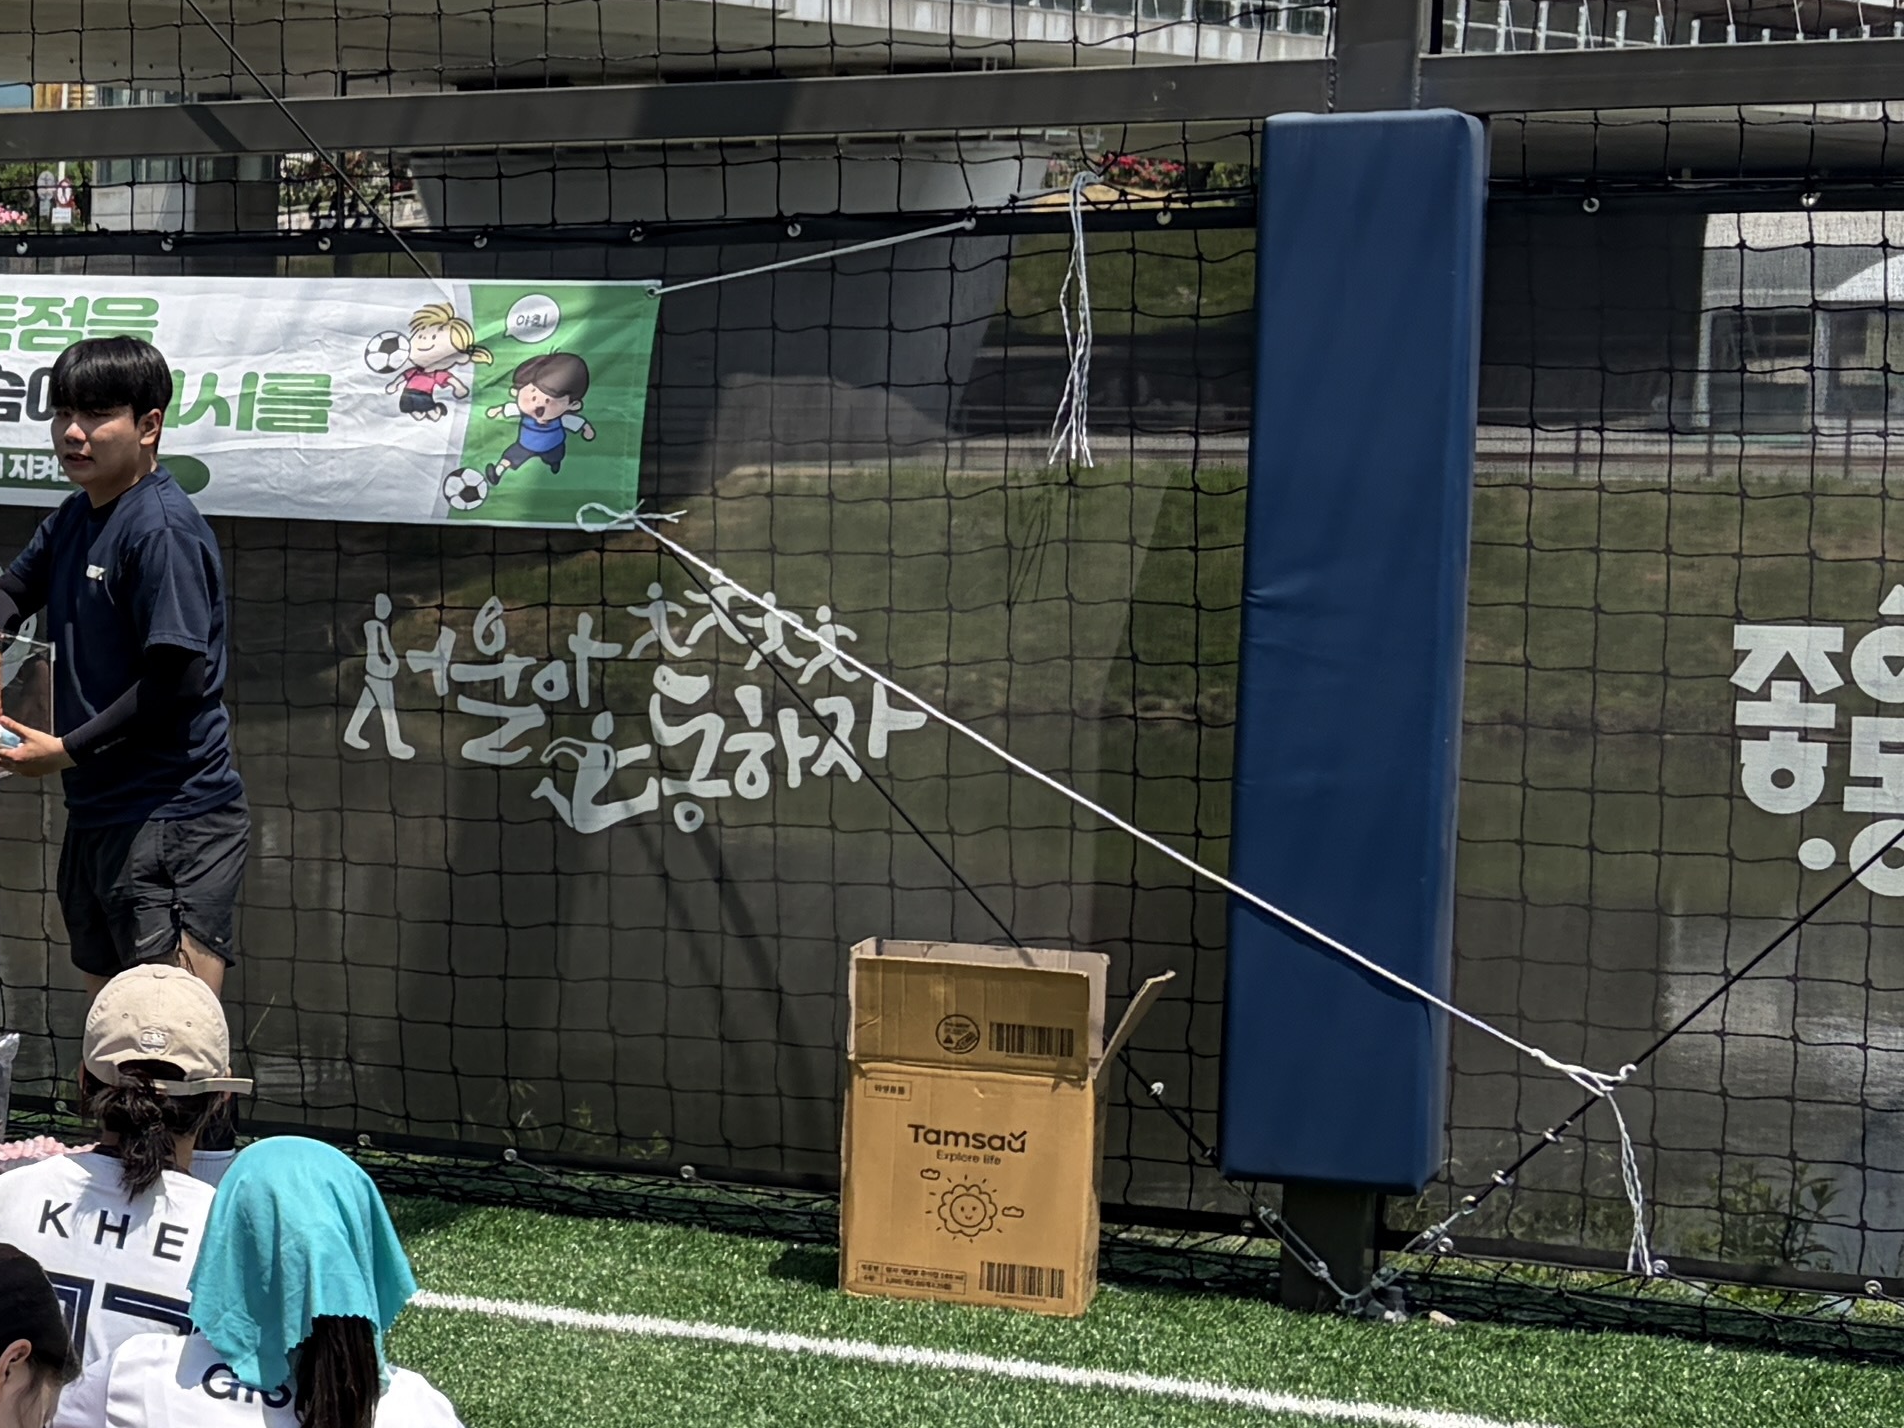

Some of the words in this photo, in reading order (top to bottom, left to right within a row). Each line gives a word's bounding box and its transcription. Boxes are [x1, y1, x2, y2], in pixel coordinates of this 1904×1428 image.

[162, 370, 332, 434] 시를
[8, 453, 69, 482] 지켜
[936, 1149, 980, 1164] Explore
[983, 1154, 1002, 1165] life
